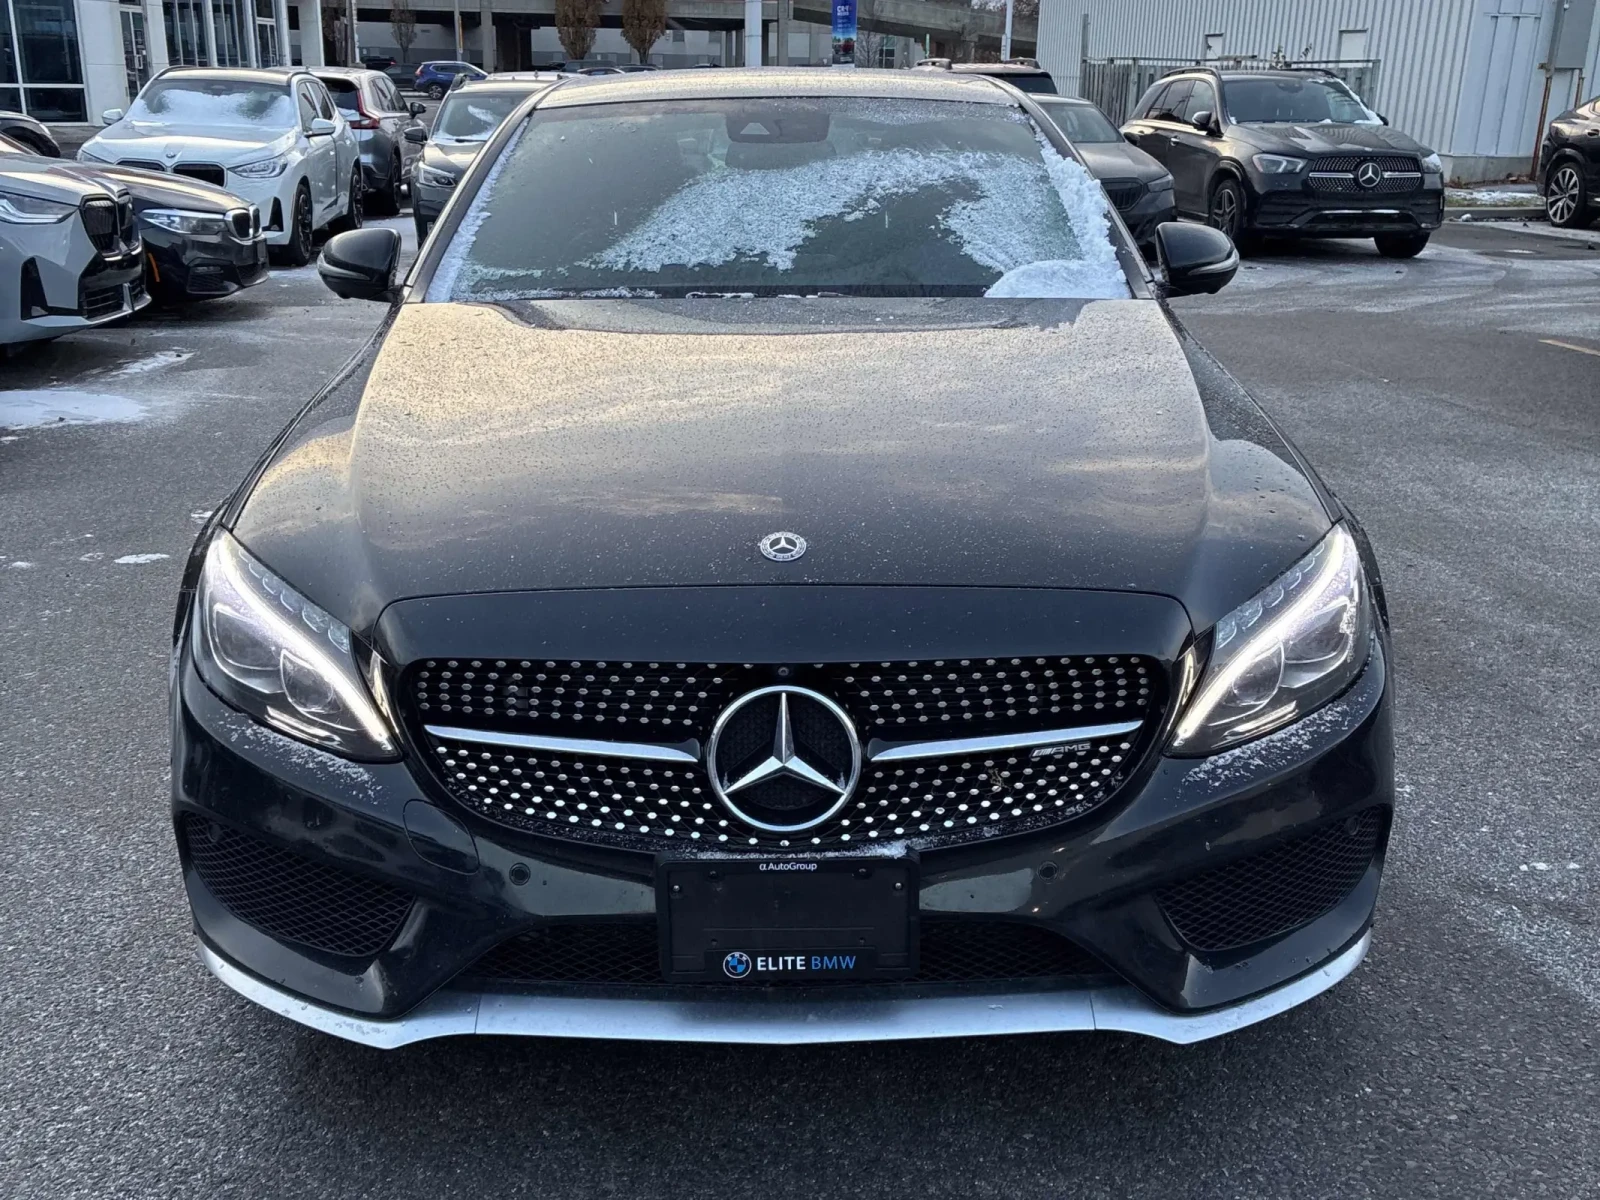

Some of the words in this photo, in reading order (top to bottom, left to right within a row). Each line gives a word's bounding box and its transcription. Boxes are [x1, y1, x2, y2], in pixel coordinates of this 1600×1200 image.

[1050, 743, 1091, 755] AMG
[768, 862, 818, 872] AutoGroup
[757, 956, 806, 971] ELITE
[811, 956, 857, 970] BMW
